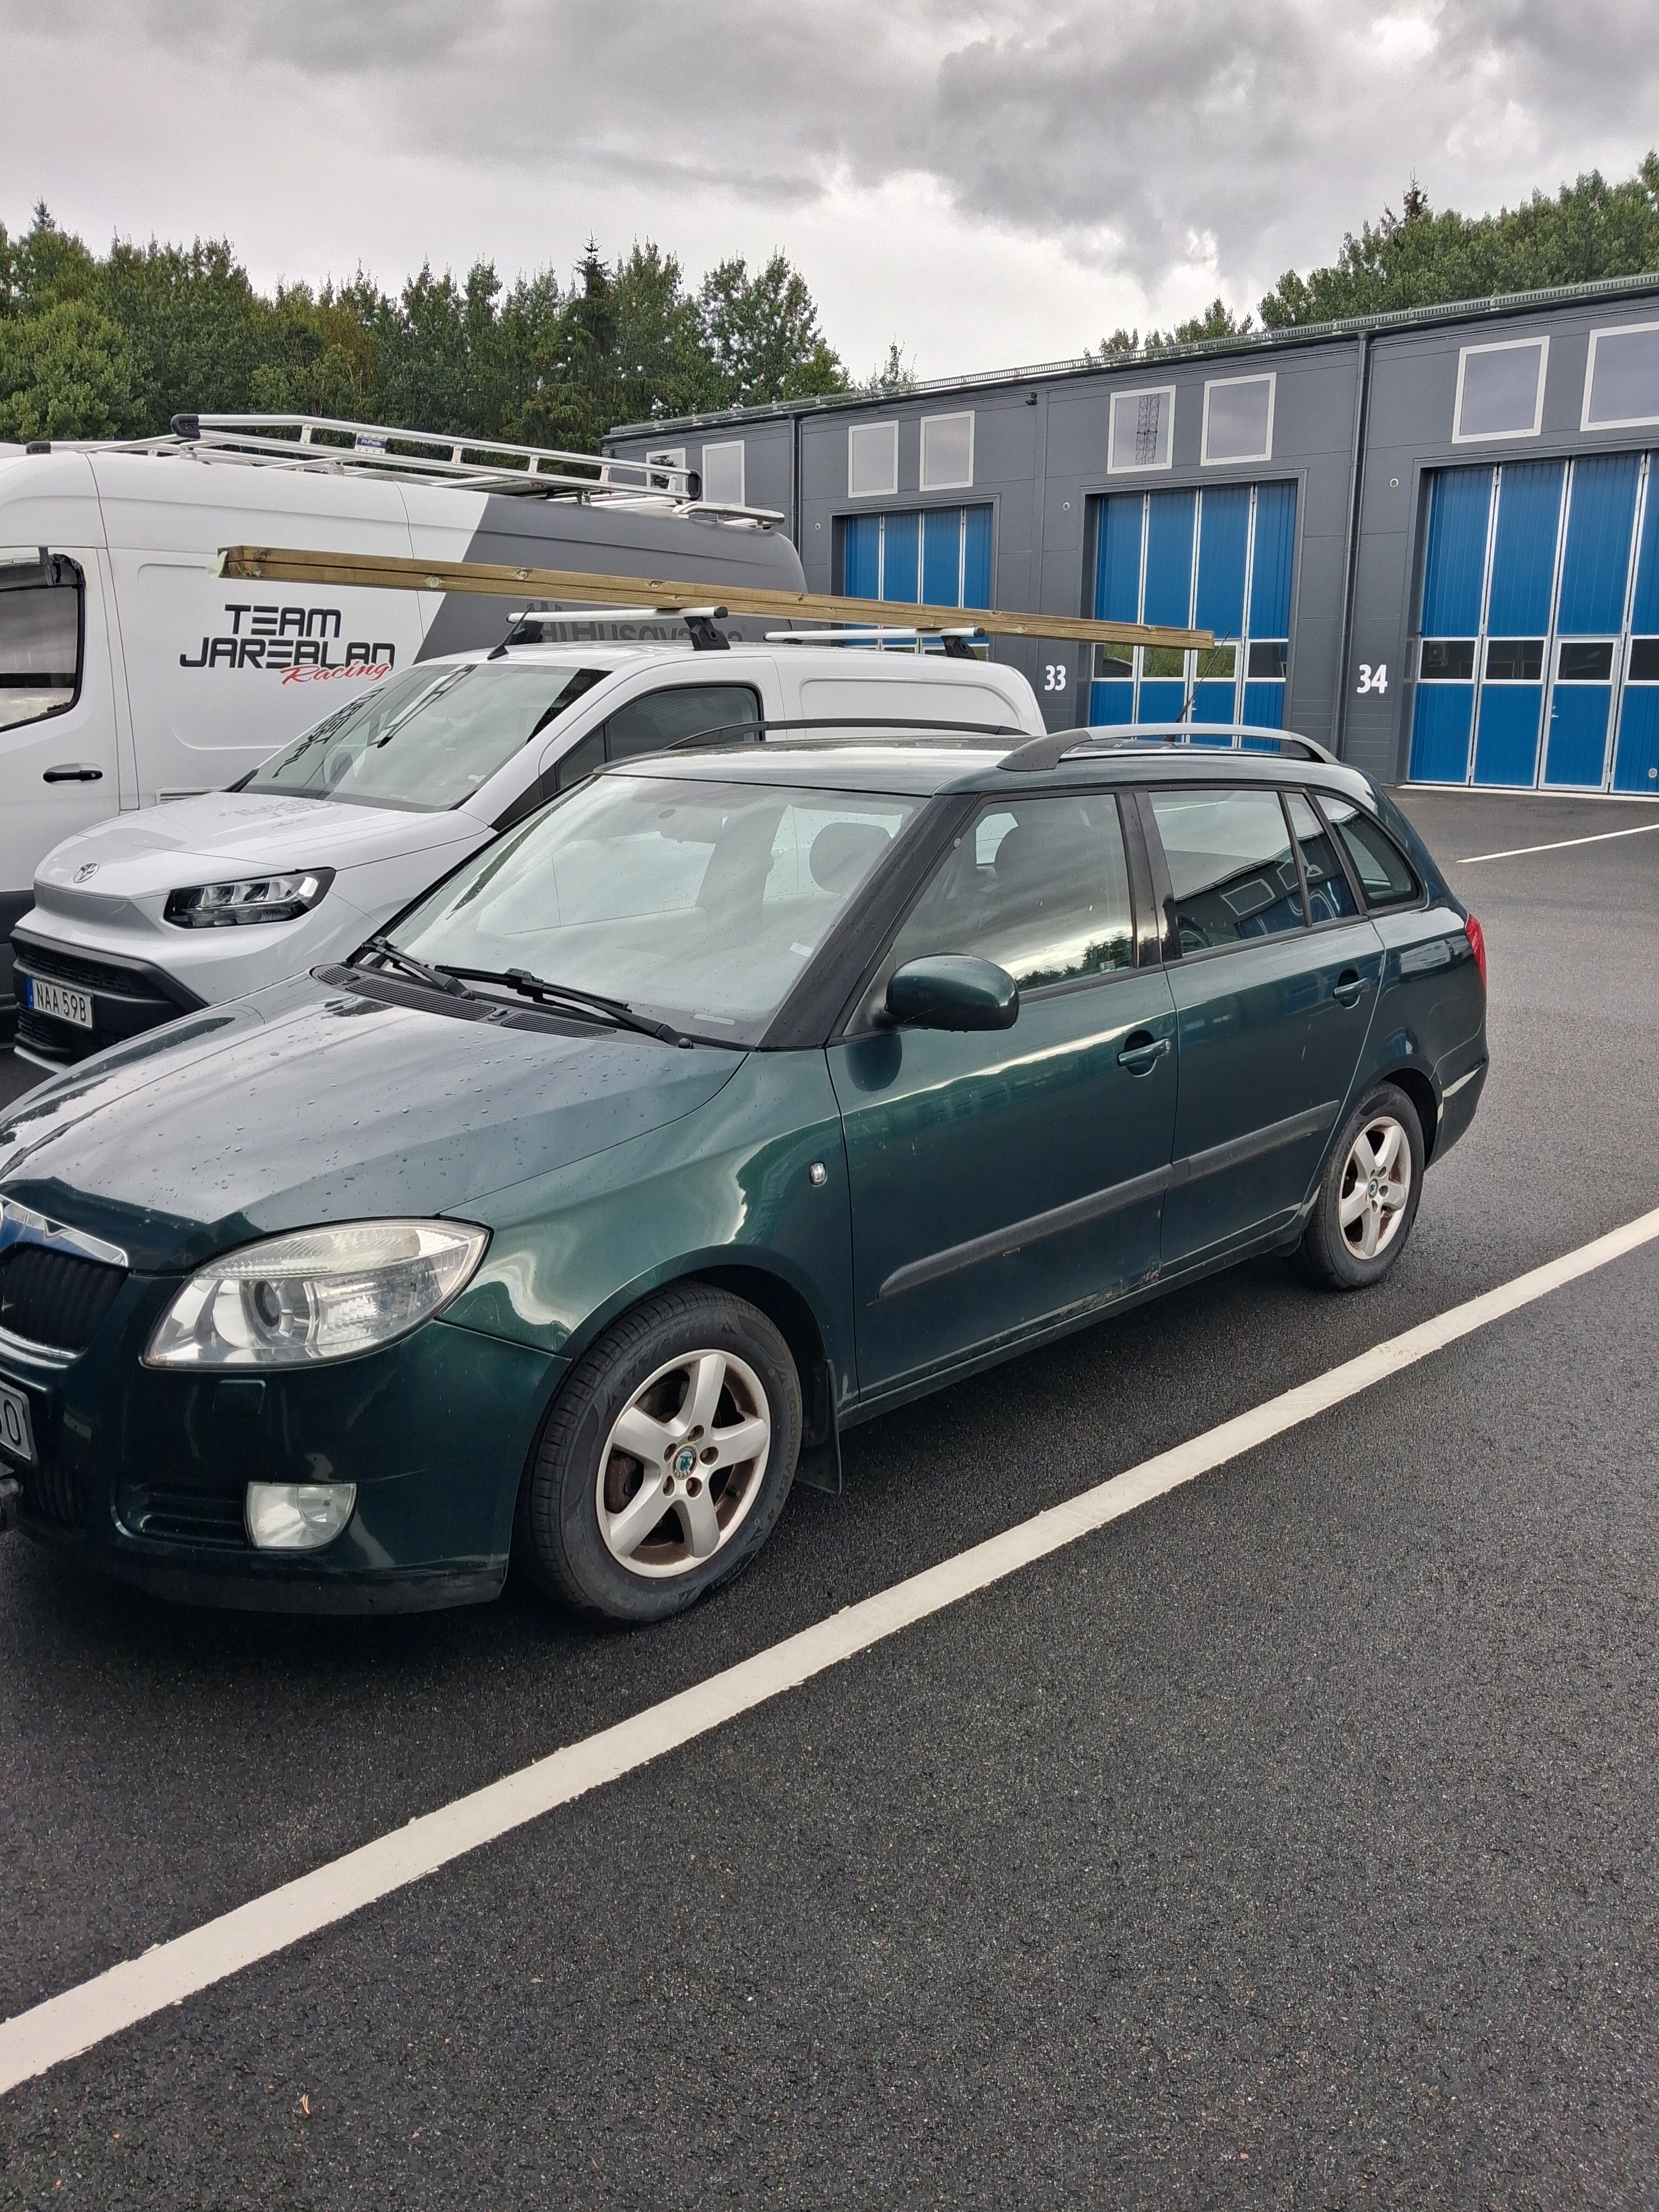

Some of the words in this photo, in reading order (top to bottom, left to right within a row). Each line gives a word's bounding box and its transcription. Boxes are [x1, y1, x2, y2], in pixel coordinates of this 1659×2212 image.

[224, 604, 341, 638] TEAM
[179, 637, 395, 671] JAREBLAD
[279, 661, 390, 685] Racing
[1044, 665, 1066, 691] 33
[1356, 664, 1388, 693] 34
[36, 983, 60, 1013] NAA
[62, 991, 86, 1021] 59B
